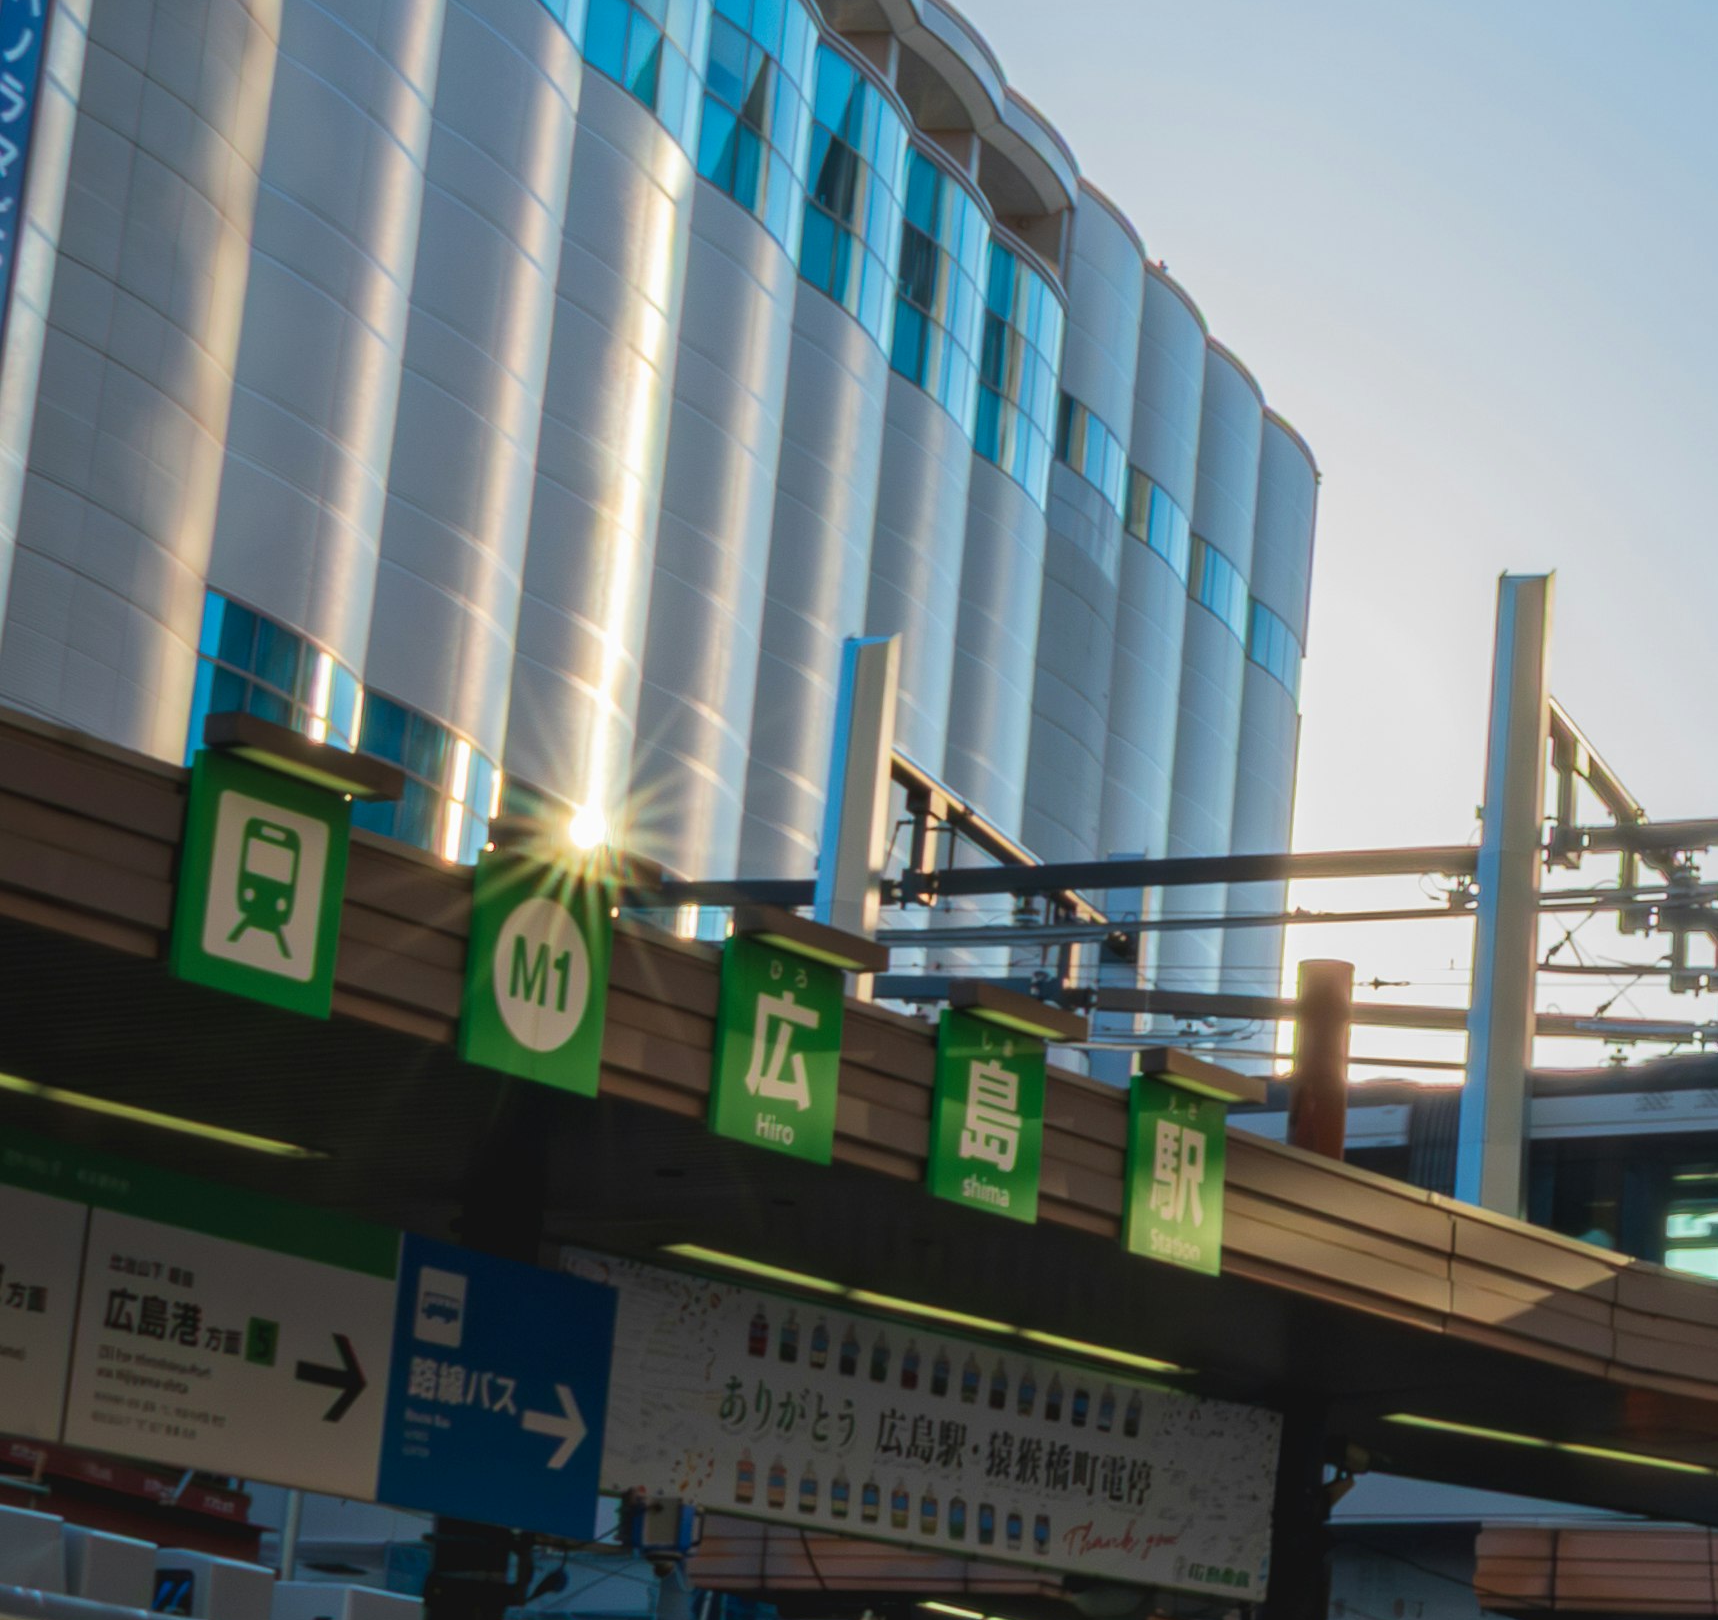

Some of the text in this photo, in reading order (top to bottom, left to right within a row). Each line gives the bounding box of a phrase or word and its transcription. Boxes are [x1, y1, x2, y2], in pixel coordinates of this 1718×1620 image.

[509, 933, 572, 1013] M1
[745, 992, 821, 1112] 広
[754, 1111, 795, 1147] Hiro
[960, 1061, 1020, 1173] 島
[962, 1174, 1011, 1209] shima
[1150, 1119, 1208, 1229] 駅
[1149, 1227, 1202, 1263] Station
[407, 1355, 518, 1416] 路線バス
[718, 1374, 857, 1448] ありがとう
